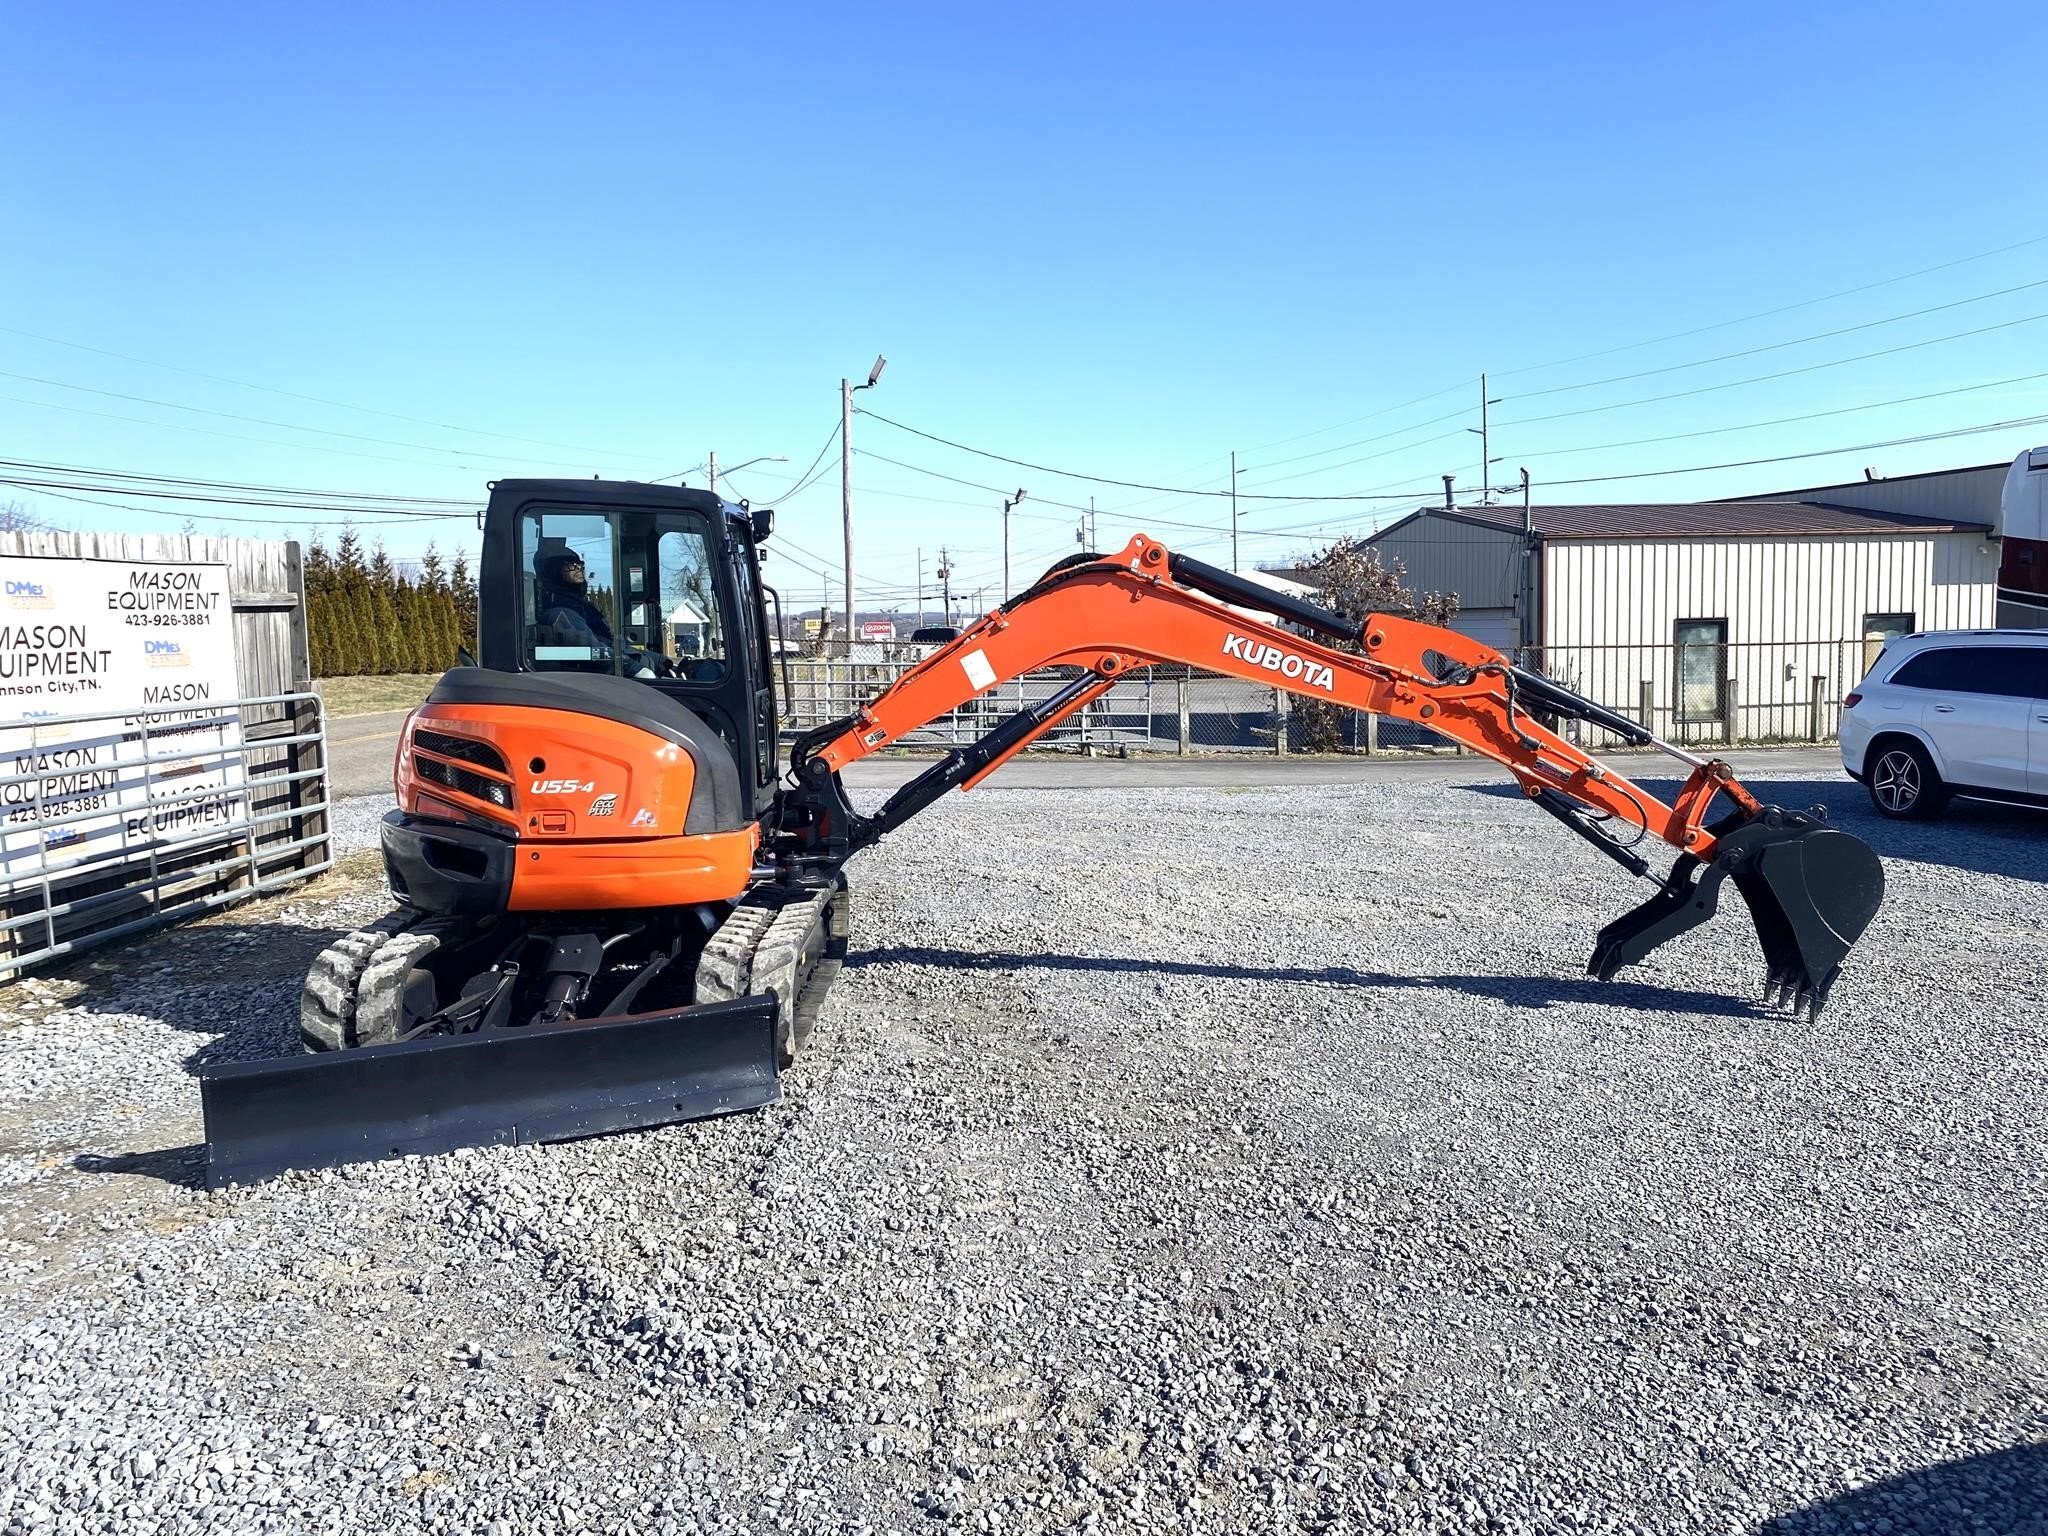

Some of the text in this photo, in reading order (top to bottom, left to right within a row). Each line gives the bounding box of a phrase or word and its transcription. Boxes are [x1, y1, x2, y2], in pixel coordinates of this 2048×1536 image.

[129, 571, 201, 590] MASON
[108, 591, 219, 610] EQUIPMENT
[125, 614, 210, 626] 423-926-3881
[1222, 632, 1334, 692] KUBOTA
[143, 682, 209, 705] MASON
[121, 721, 230, 742] wwwmasonequipment.com
[16, 748, 97, 774] MASON
[0, 769, 119, 806] QUIPMENT
[530, 780, 595, 794] U55-4
[10, 795, 108, 823] 423926-3881
[589, 808, 614, 816] PLUS
[596, 800, 615, 808] eco
